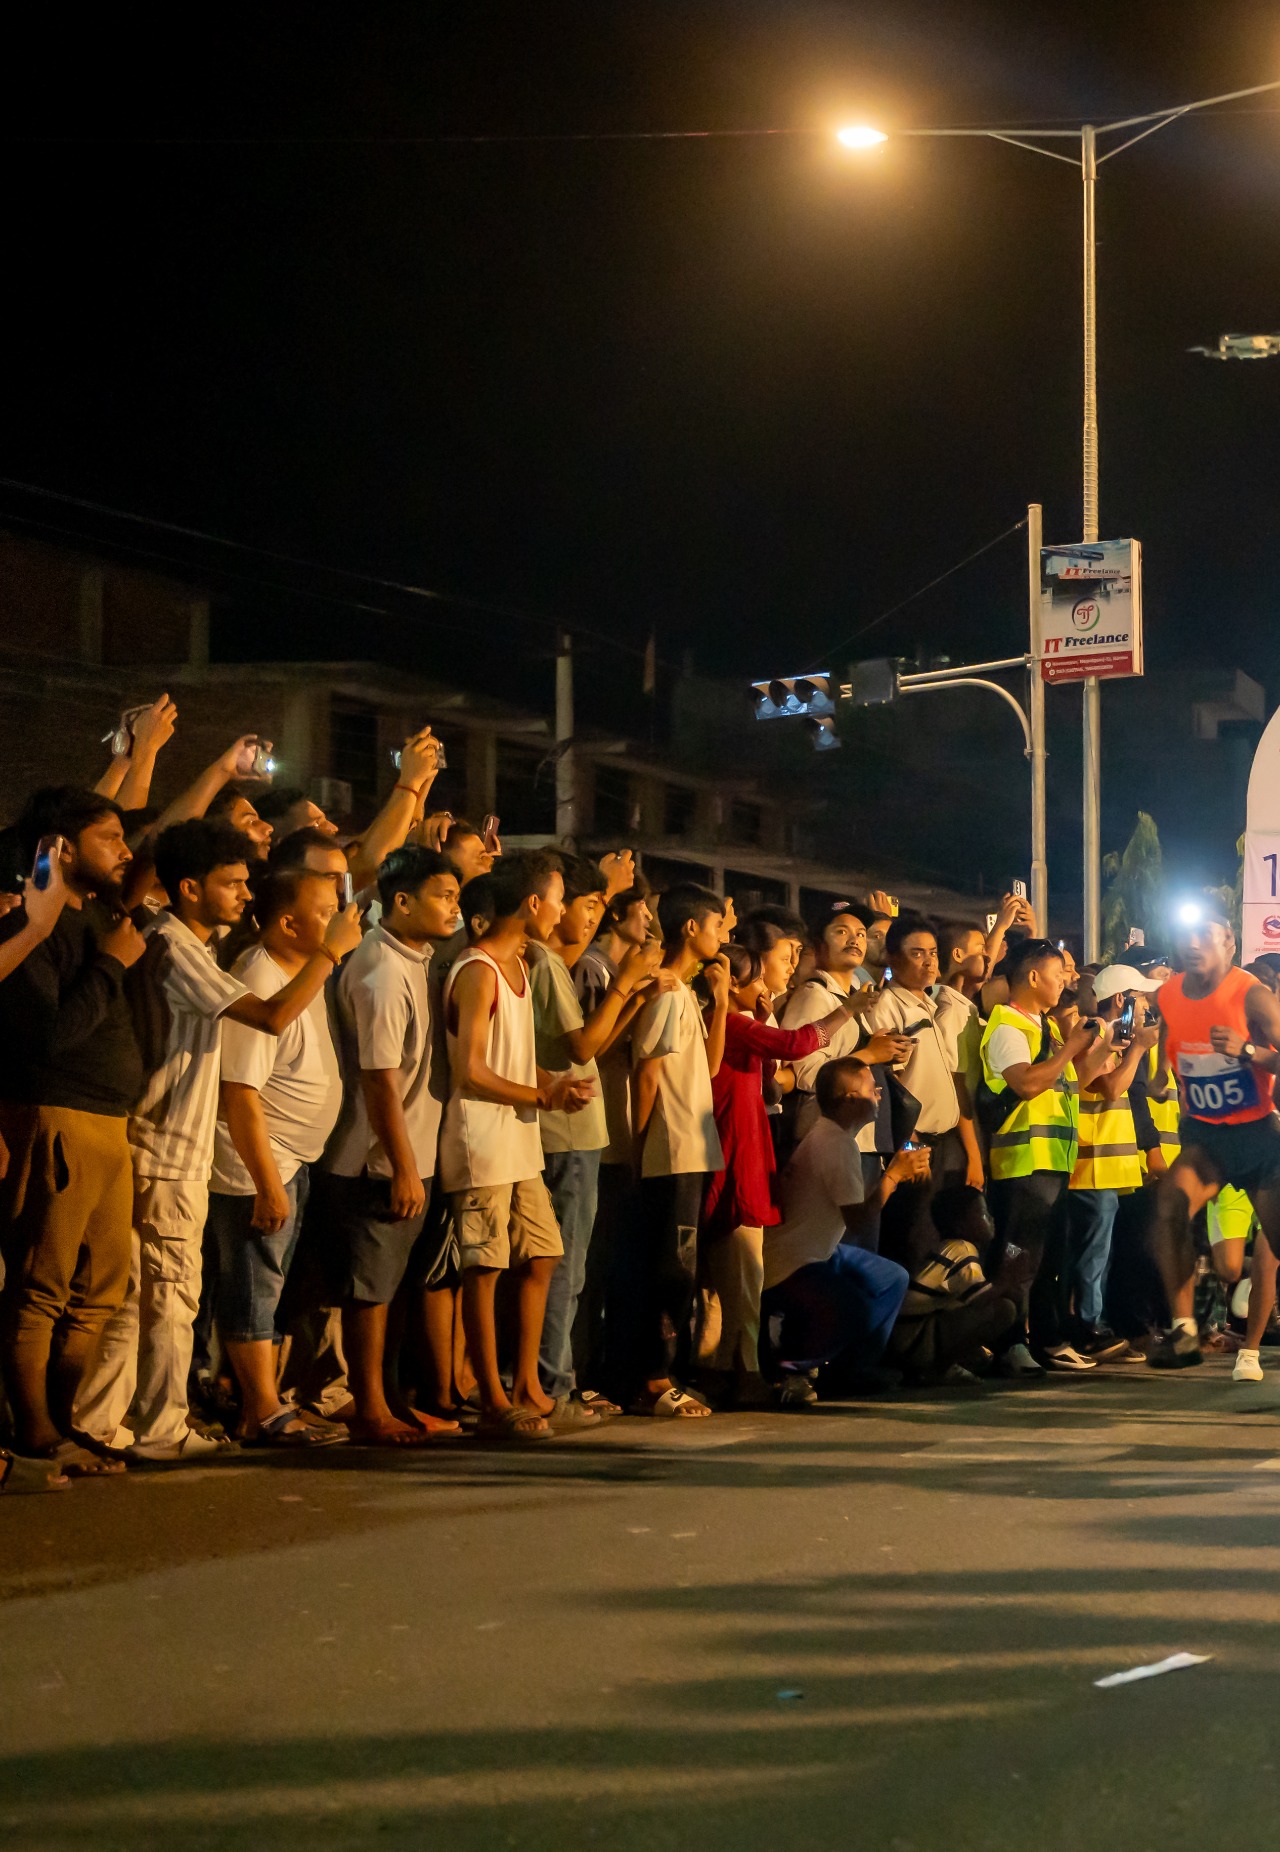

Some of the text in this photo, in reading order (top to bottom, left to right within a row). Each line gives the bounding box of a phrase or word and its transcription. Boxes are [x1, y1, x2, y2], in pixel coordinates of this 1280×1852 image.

[1064, 567, 1083, 576] IT
[1044, 637, 1063, 654] IT
[1064, 633, 1129, 648] Freelance
[1189, 1078, 1244, 1109] 005
